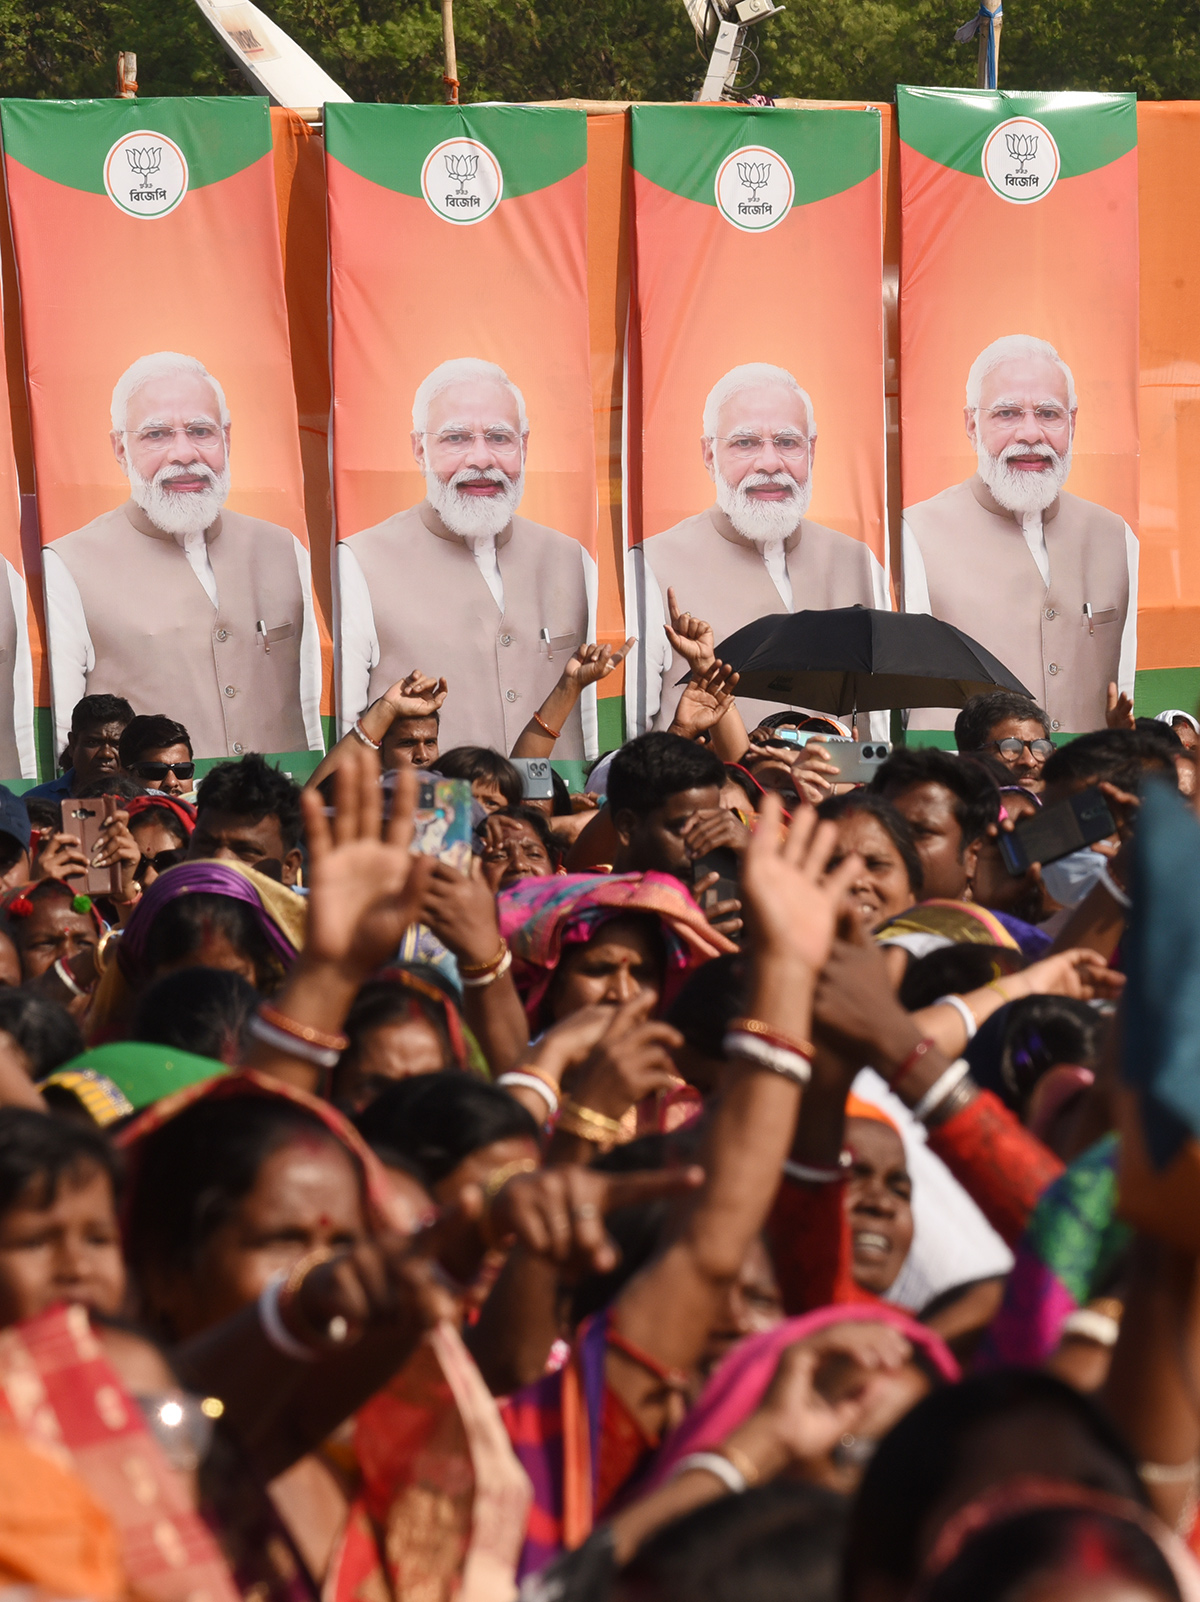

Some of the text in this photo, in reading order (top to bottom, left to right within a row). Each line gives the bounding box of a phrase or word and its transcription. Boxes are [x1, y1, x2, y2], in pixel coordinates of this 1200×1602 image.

[1005, 174, 1040, 187] বিজেপি
[130, 187, 167, 201] বিজেপি
[446, 194, 481, 208] বিজেপি
[738, 203, 773, 215] বিজেপি
